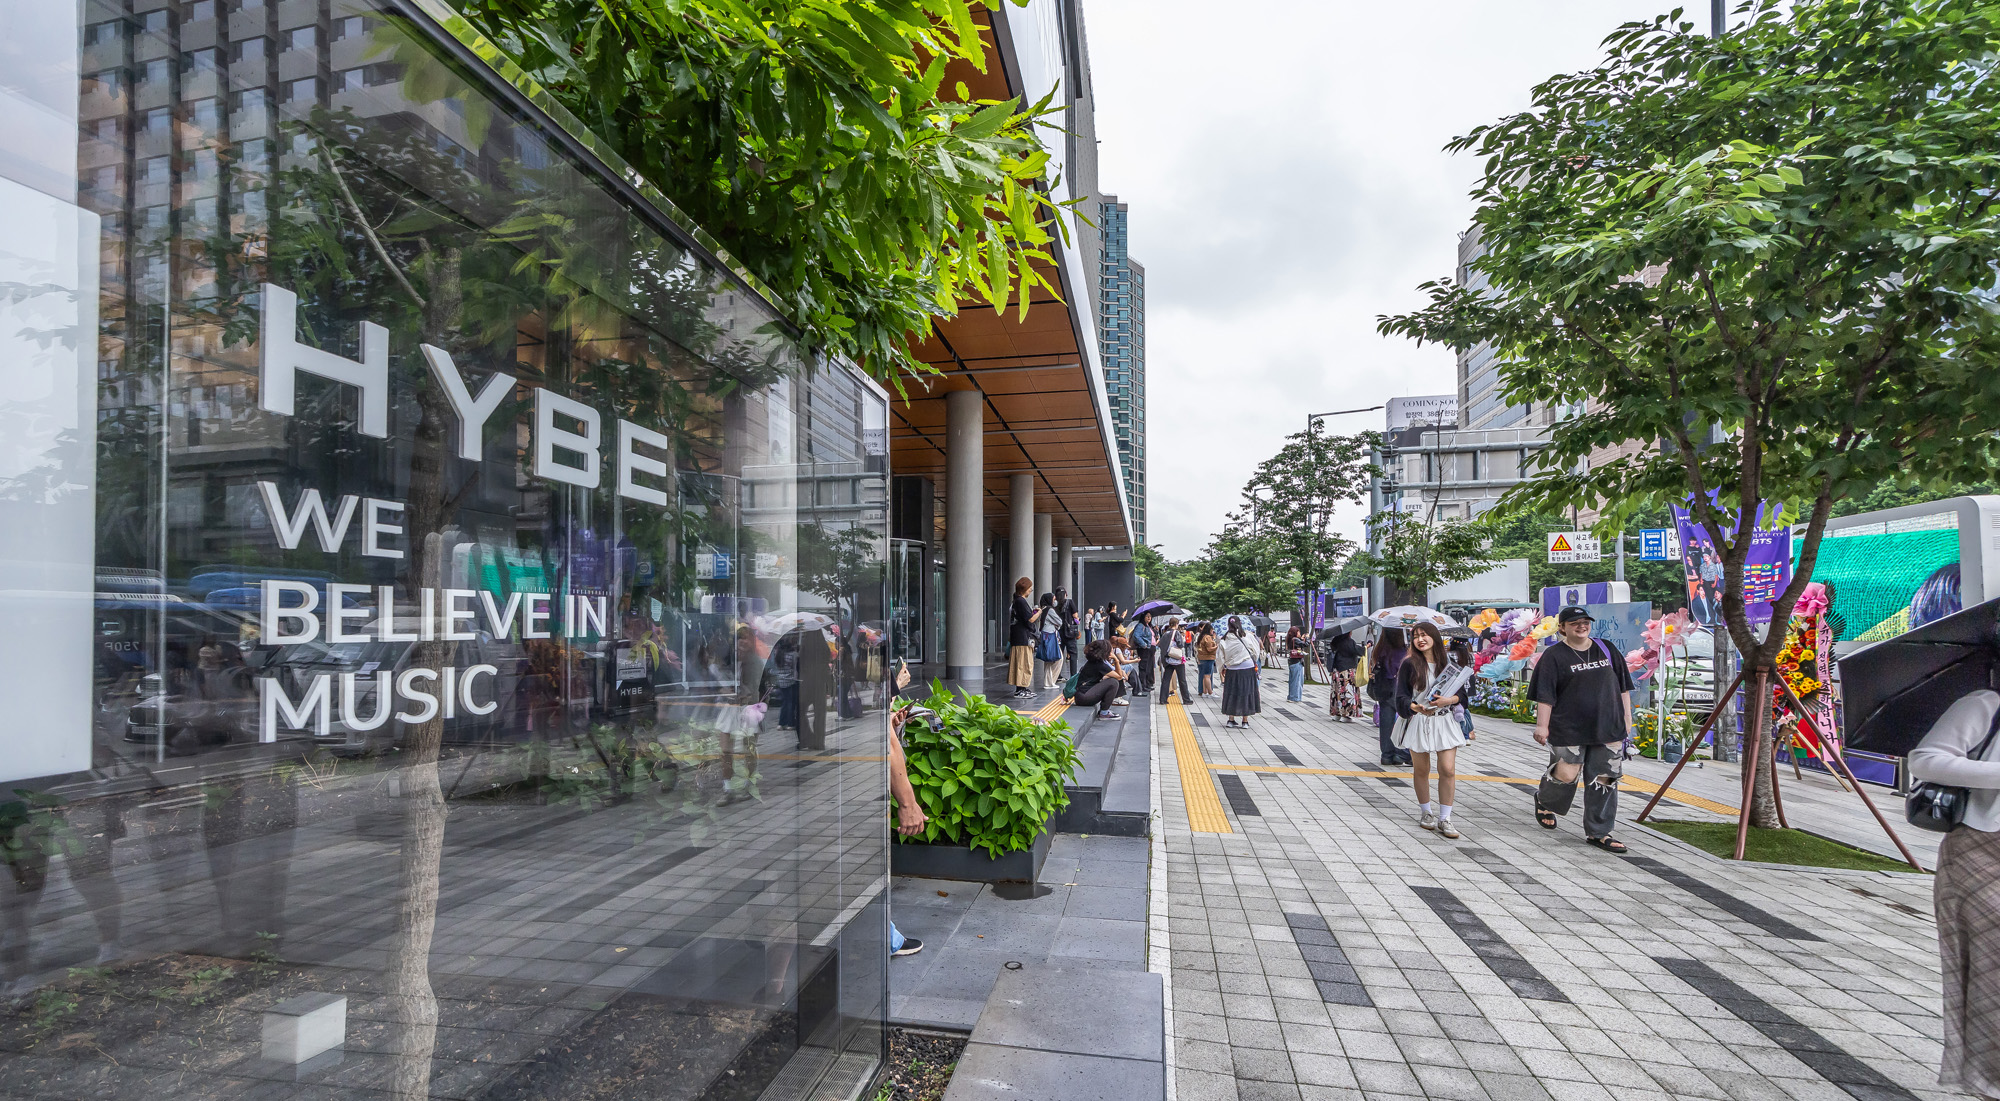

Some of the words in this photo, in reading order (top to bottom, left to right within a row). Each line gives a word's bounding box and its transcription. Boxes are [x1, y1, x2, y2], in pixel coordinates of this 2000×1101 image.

[258, 283, 668, 506] HYBE
[1403, 399, 1438, 408] COMING
[257, 481, 405, 559] WE
[261, 580, 551, 645] BELIEVE
[564, 594, 608, 638] IN
[620, 687, 643, 696] HYBE
[1570, 661, 1600, 673] PEACE
[1599, 659, 1610, 667] OU
[258, 663, 498, 743] MUSIC
